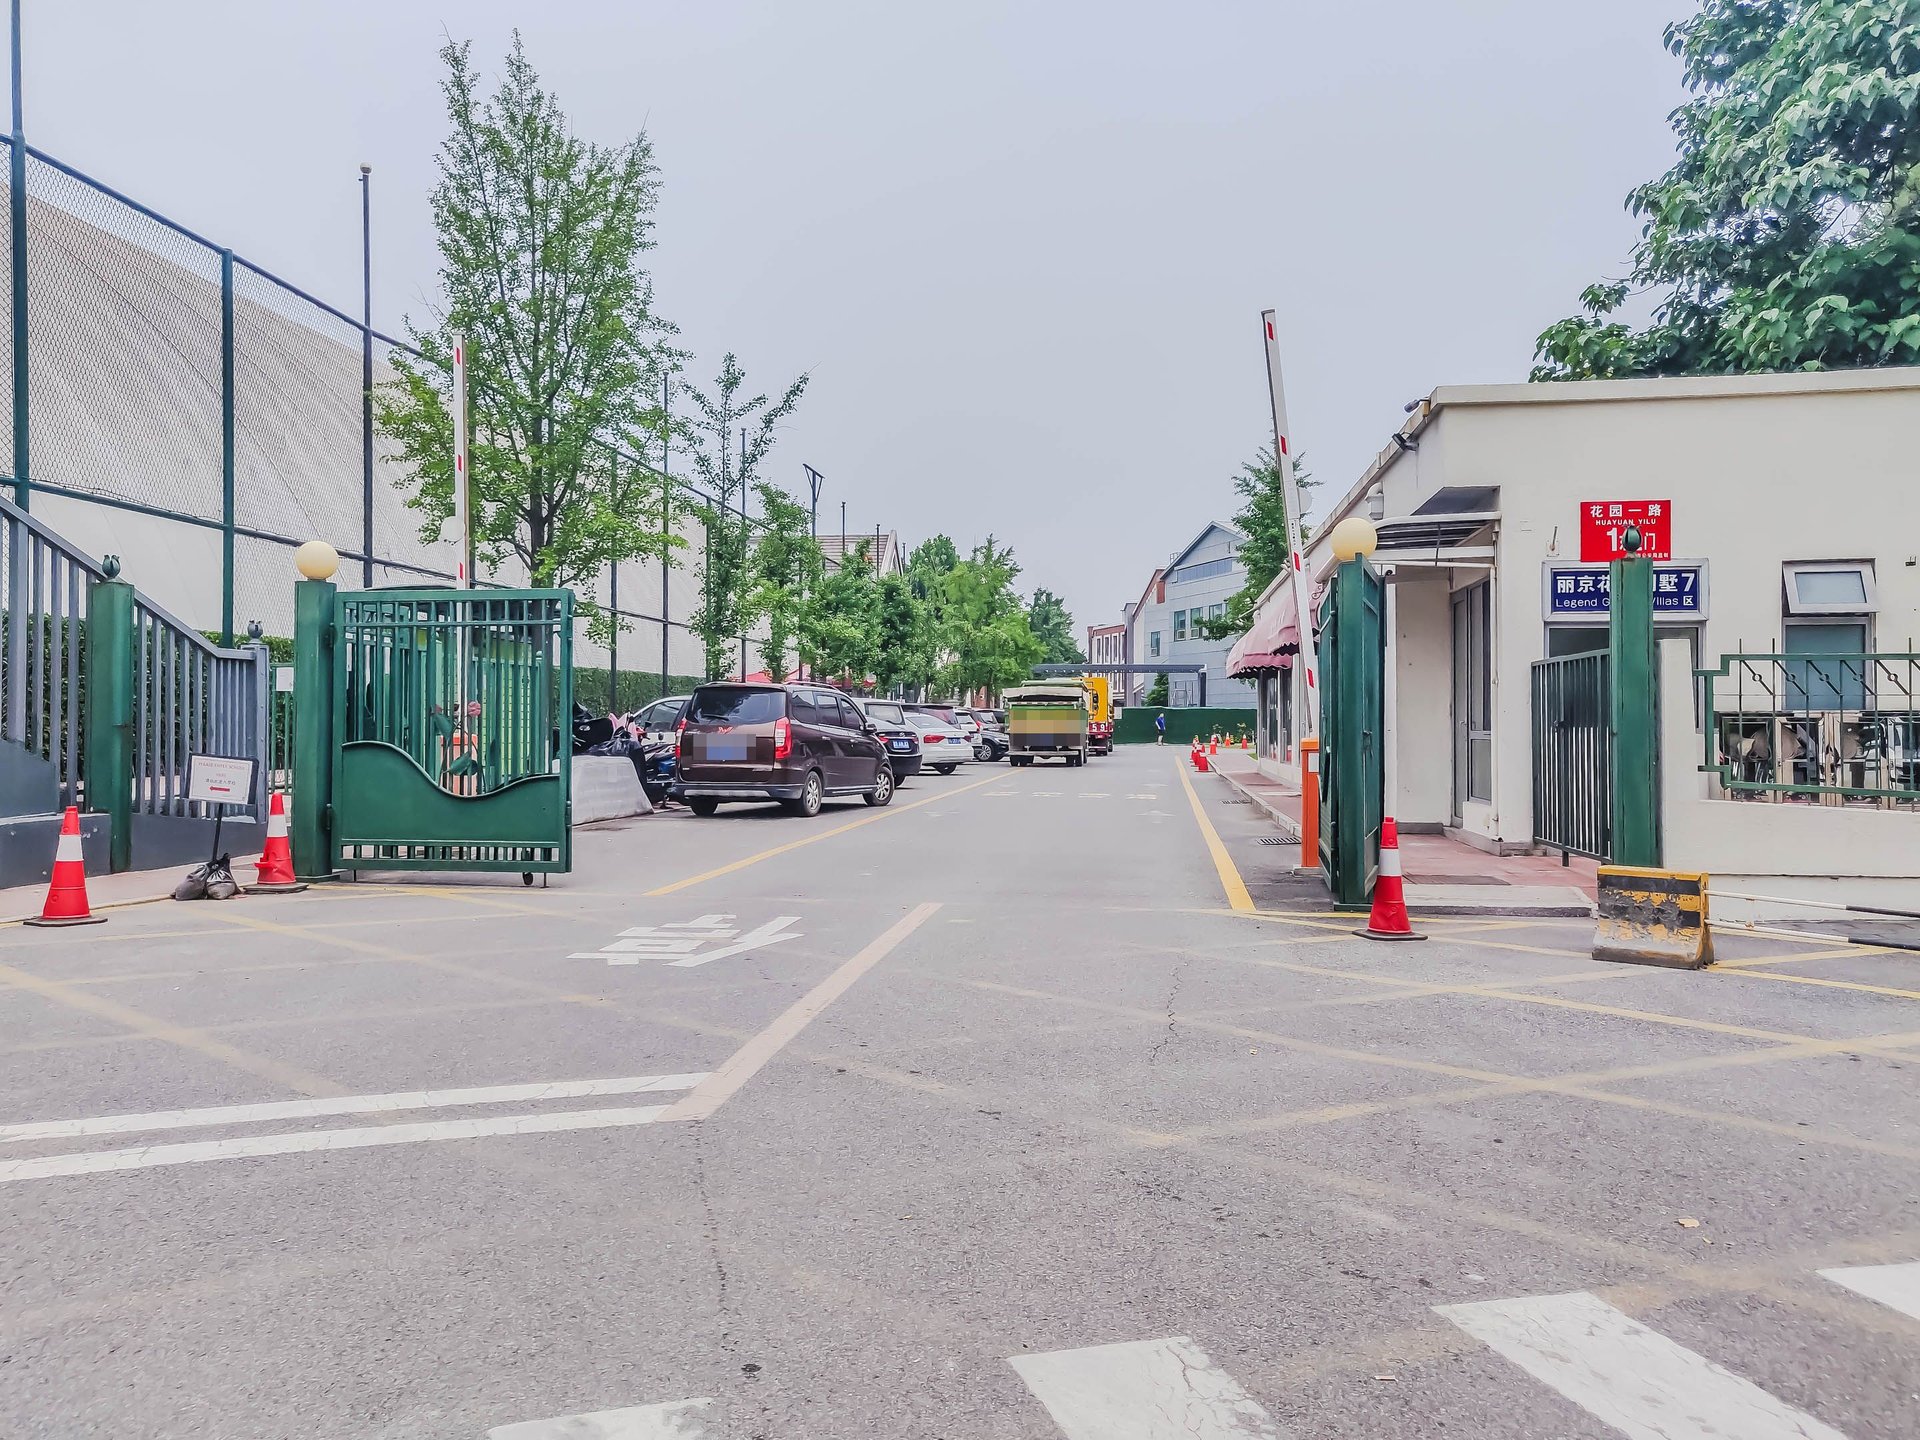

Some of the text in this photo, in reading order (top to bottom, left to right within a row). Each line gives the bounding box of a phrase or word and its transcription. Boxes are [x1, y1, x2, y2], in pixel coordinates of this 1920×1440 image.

[1590, 504, 1662, 518] 花园一路
[1555, 597, 1598, 608] Legend
[1683, 595, 1694, 606] 区
